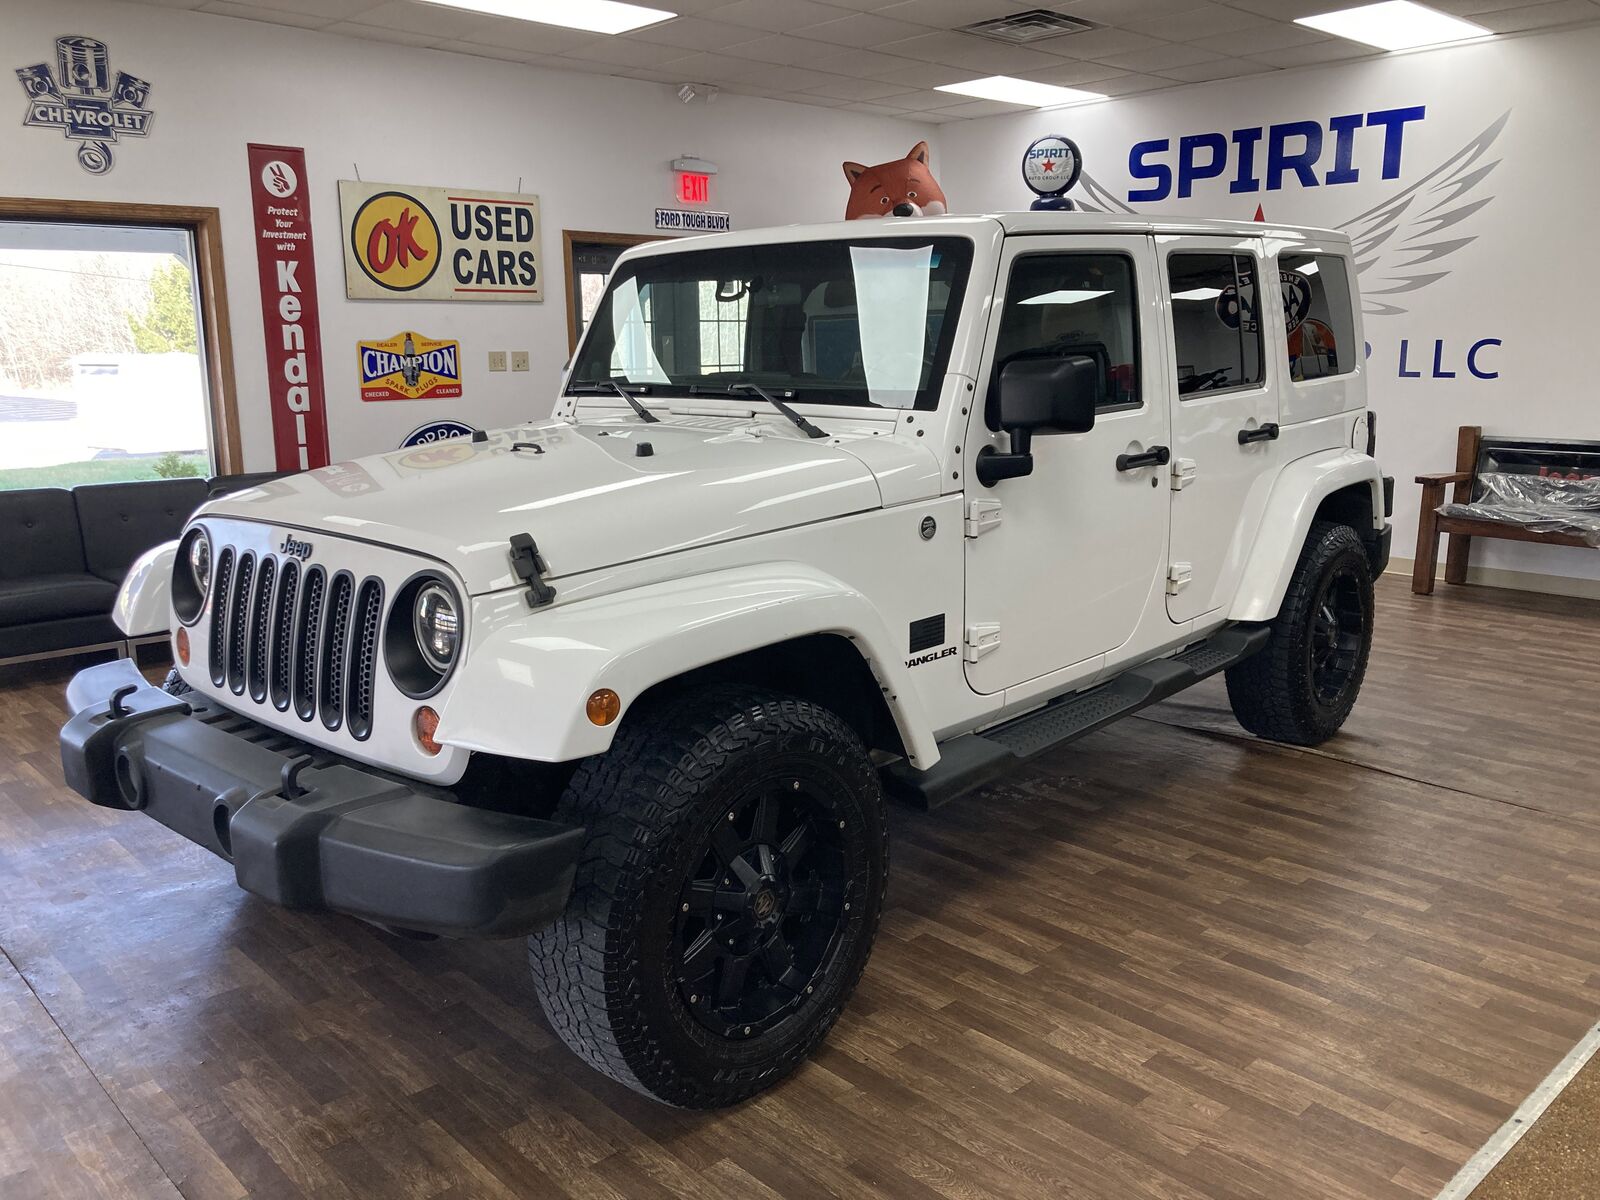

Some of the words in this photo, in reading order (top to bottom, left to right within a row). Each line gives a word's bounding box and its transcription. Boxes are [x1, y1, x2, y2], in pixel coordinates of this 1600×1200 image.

[35, 105, 142, 129] CHEVROLET
[1030, 148, 1070, 159] SPIRIT
[1128, 105, 1426, 202] SPIRIT
[682, 174, 709, 202] EXIT
[267, 206, 299, 217] Protect
[275, 219, 293, 228] Your
[450, 203, 534, 243] USED
[661, 212, 681, 226] FORD
[682, 213, 706, 229] TOUGH
[707, 215, 725, 229] BLVD
[262, 230, 307, 240] Investment
[276, 243, 296, 251] with
[367, 207, 429, 274] OK
[453, 248, 537, 286] CARS
[276, 260, 310, 470] Kendall
[363, 348, 455, 378] CHAMPION
[1399, 338, 1502, 380] LLC
[385, 378, 410, 394] SPARK
[415, 377, 438, 394] PLUGS
[280, 534, 313, 562] Jeep
